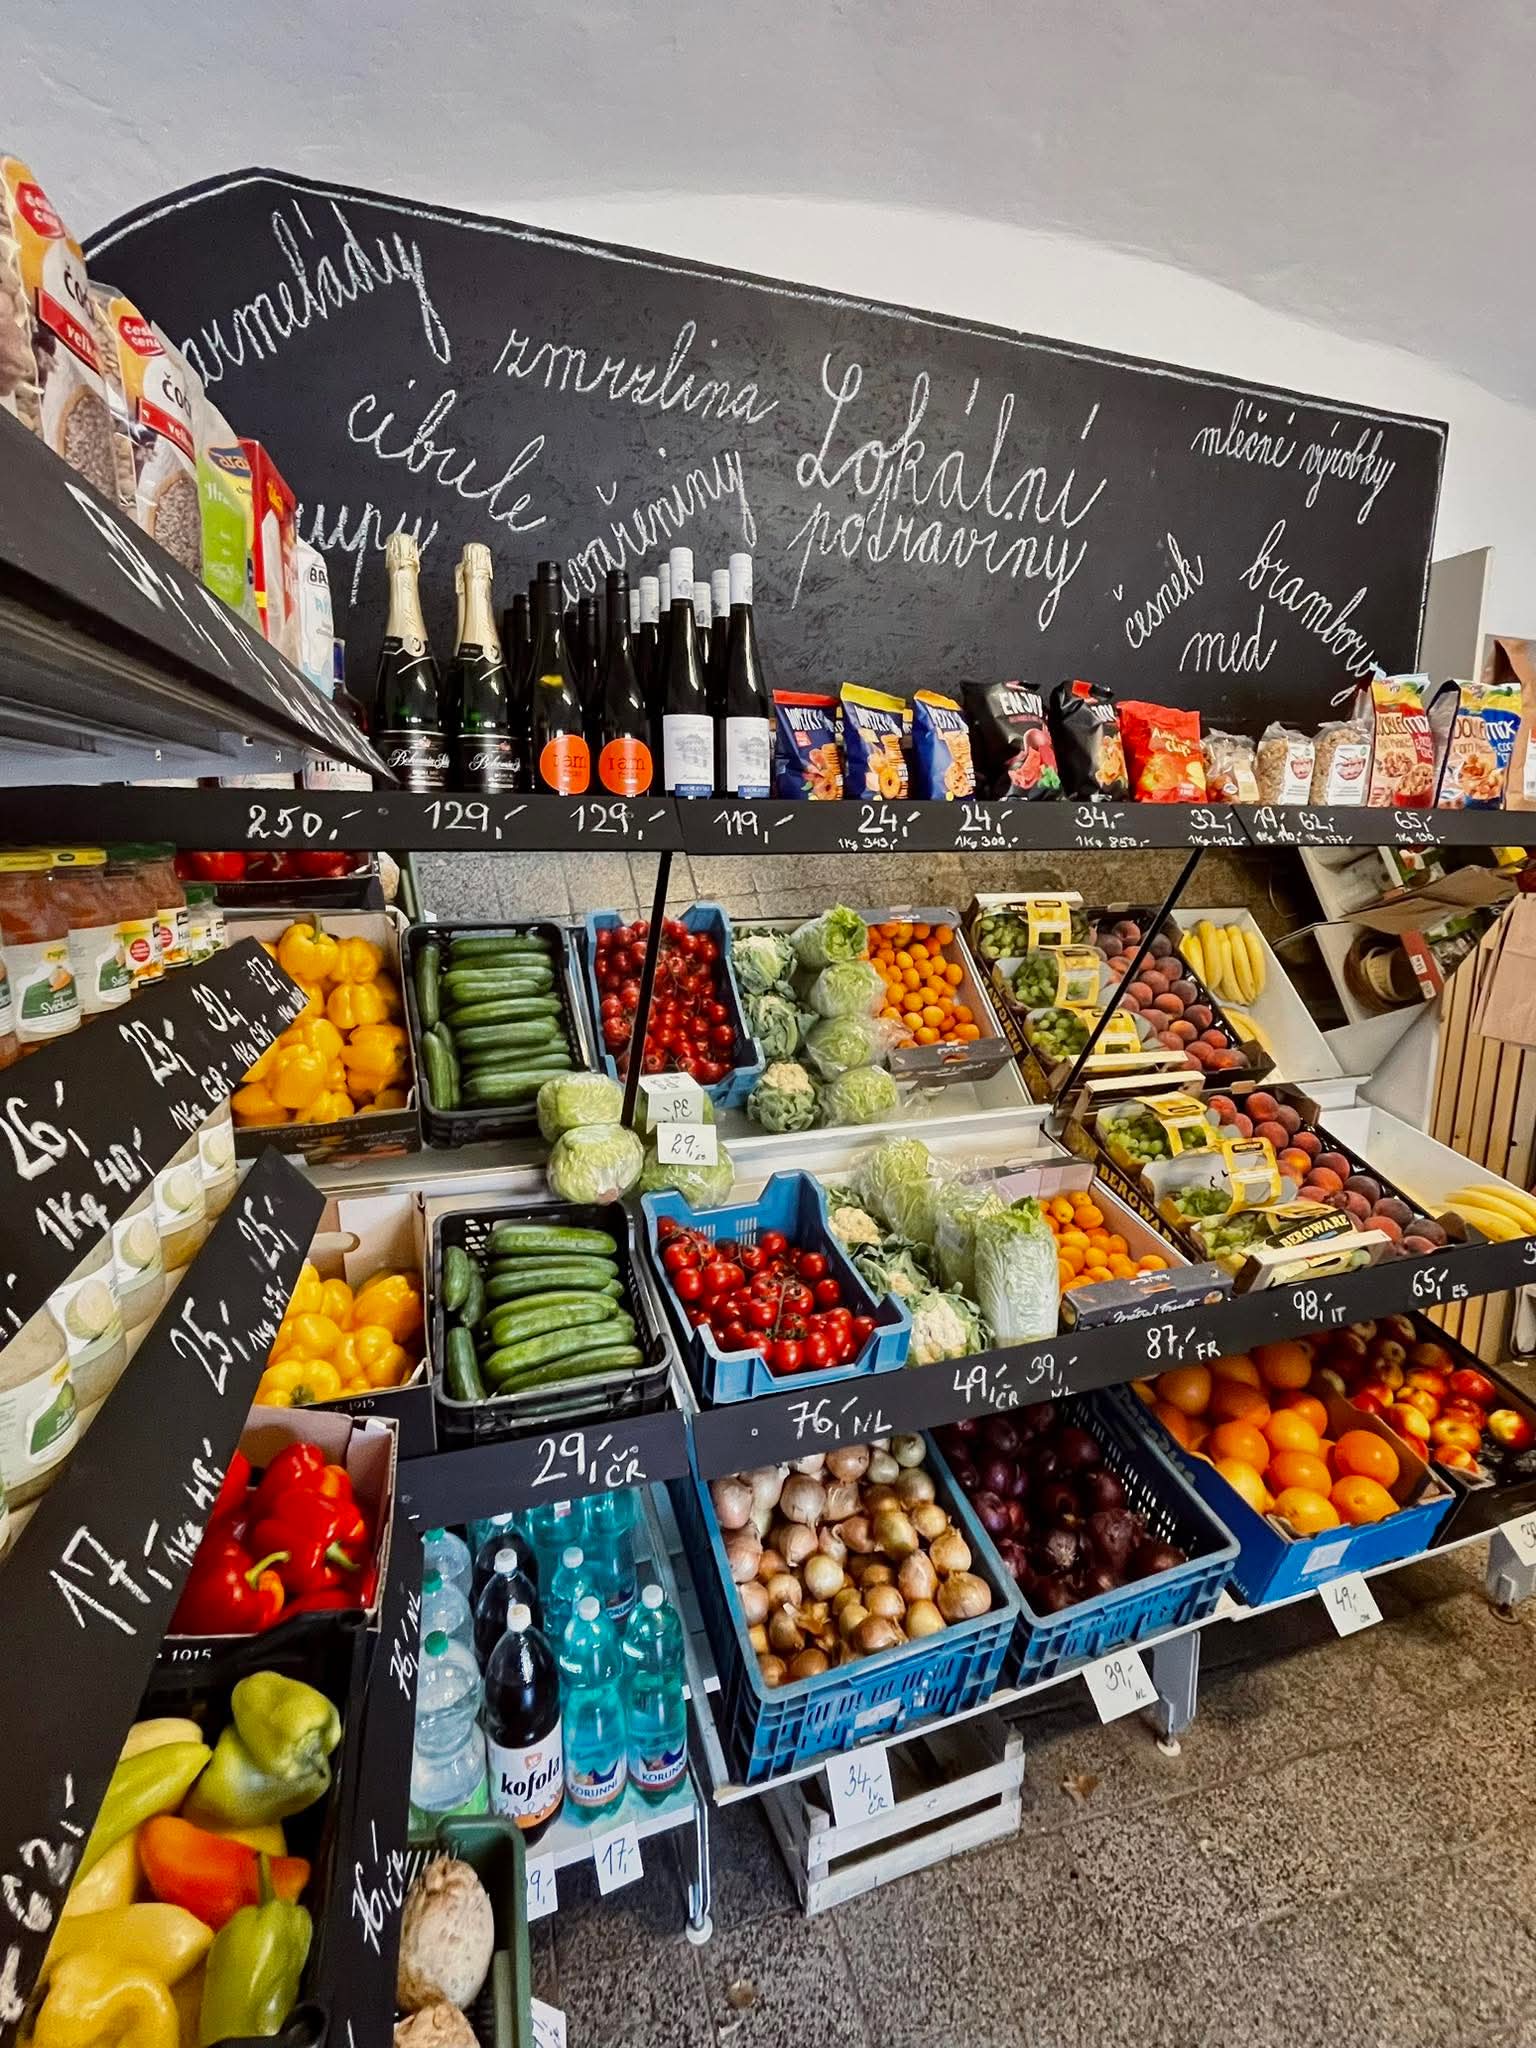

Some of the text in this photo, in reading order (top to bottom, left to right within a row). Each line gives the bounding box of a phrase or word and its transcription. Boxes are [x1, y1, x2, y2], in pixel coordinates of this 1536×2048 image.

[182, 199, 452, 388] armelády
[492, 320, 778, 423] zmrzlina
[348, 379, 547, 532] cibule
[1190, 398, 1396, 524] mléčné výrobky
[1112, 533, 1206, 648] česnek
[1239, 519, 1373, 707] brambory
[1179, 604, 1277, 673] med
[424, 801, 528, 839] 129,-
[569, 802, 666, 840] 129,-
[1279, 1213, 1350, 1249] BERGWARE
[1331, 1306, 1347, 1323] IT
[1195, 1340, 1221, 1361] FR
[854, 1412, 893, 1437] NL
[500, 1756, 560, 1802] kofola
[530, 1870, 553, 1905] 9,-
